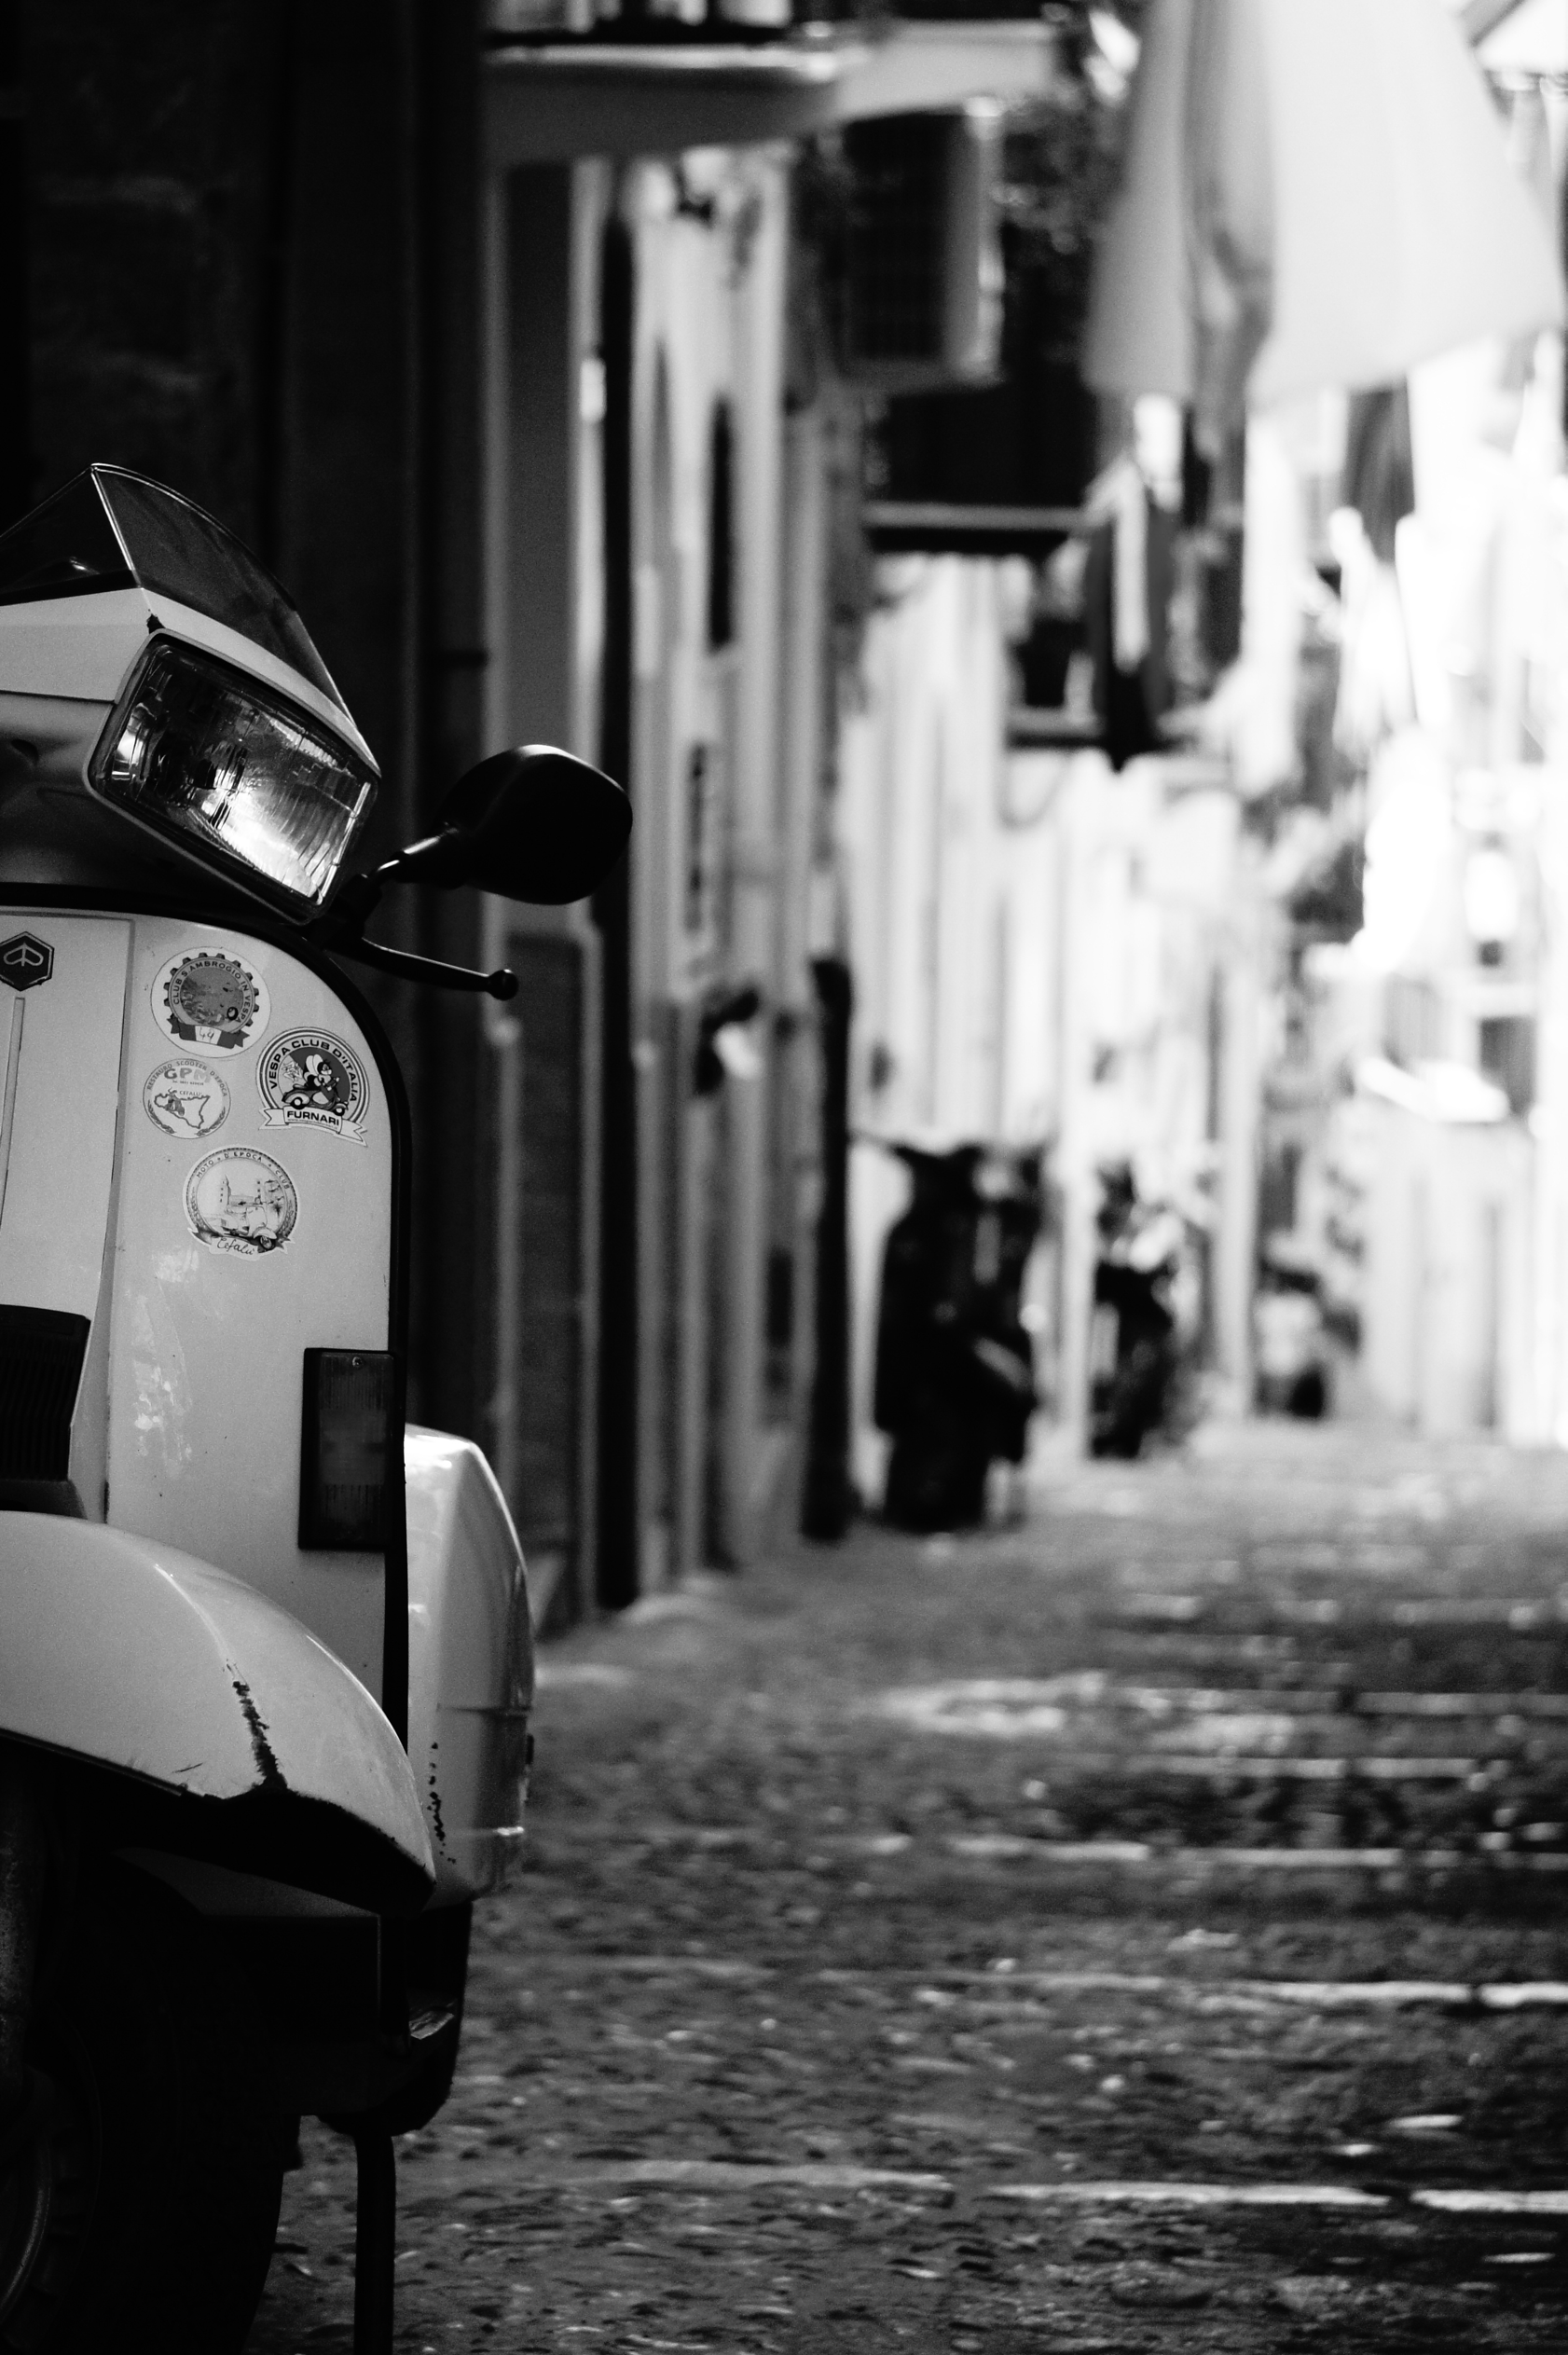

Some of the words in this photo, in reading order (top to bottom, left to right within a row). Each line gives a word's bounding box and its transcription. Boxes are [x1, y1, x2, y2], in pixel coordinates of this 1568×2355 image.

[189, 960, 241, 980] AMBROGIO
[173, 978, 183, 1005] CLUB
[241, 981, 249, 992] IN
[235, 995, 251, 1024] VESPA
[146, 1064, 172, 1091] RESTAURO
[176, 1060, 208, 1071] SCOOTER
[268, 1046, 291, 1090] VESPA
[291, 1039, 330, 1051] CLUB
[332, 1048, 358, 1102] D'ITALIA
[287, 1110, 339, 1126] FURNARI
[196, 1160, 214, 1178] MOTO
[275, 1169, 290, 1190] CLUB
